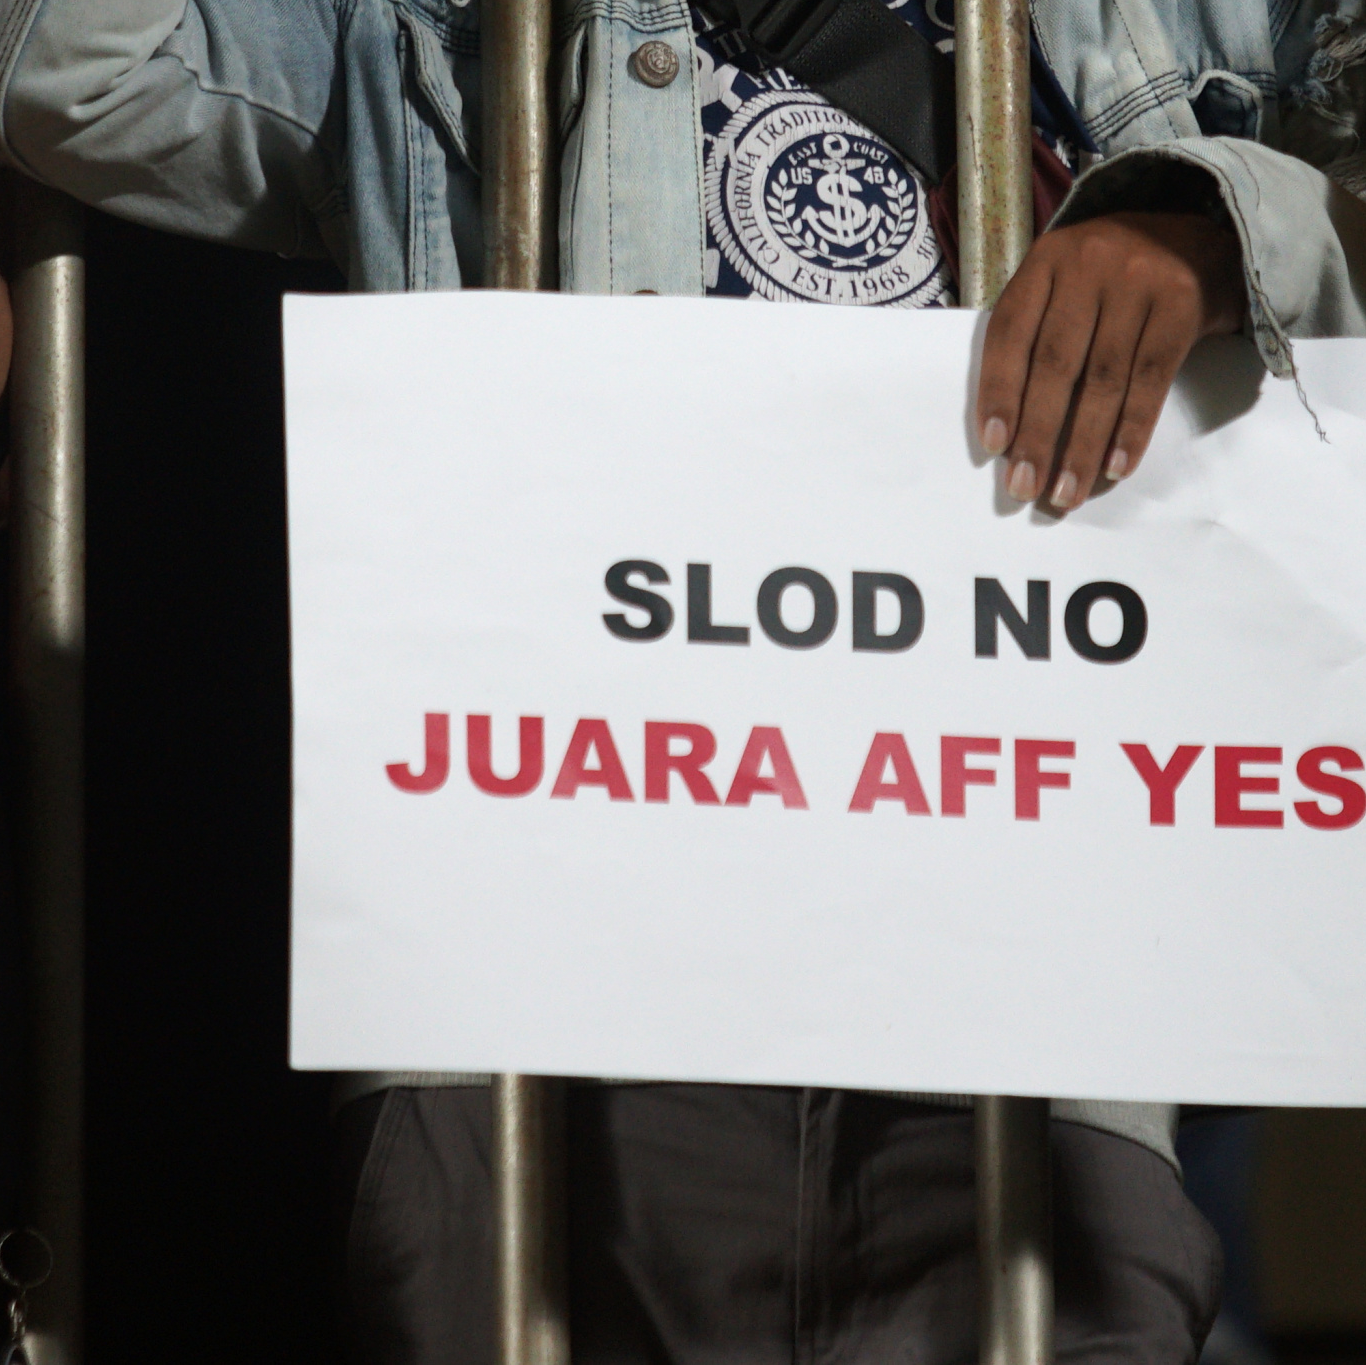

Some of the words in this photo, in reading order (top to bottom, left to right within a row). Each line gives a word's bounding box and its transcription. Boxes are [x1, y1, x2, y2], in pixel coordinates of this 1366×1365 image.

[734, 151, 782, 266] CALIFORNIA
[791, 168, 813, 185] US
[851, 264, 911, 298] 1968
[602, 559, 925, 652] SLOD
[974, 577, 1149, 665] NO
[385, 713, 806, 806] JUARA
[849, 732, 1076, 819] AFF
